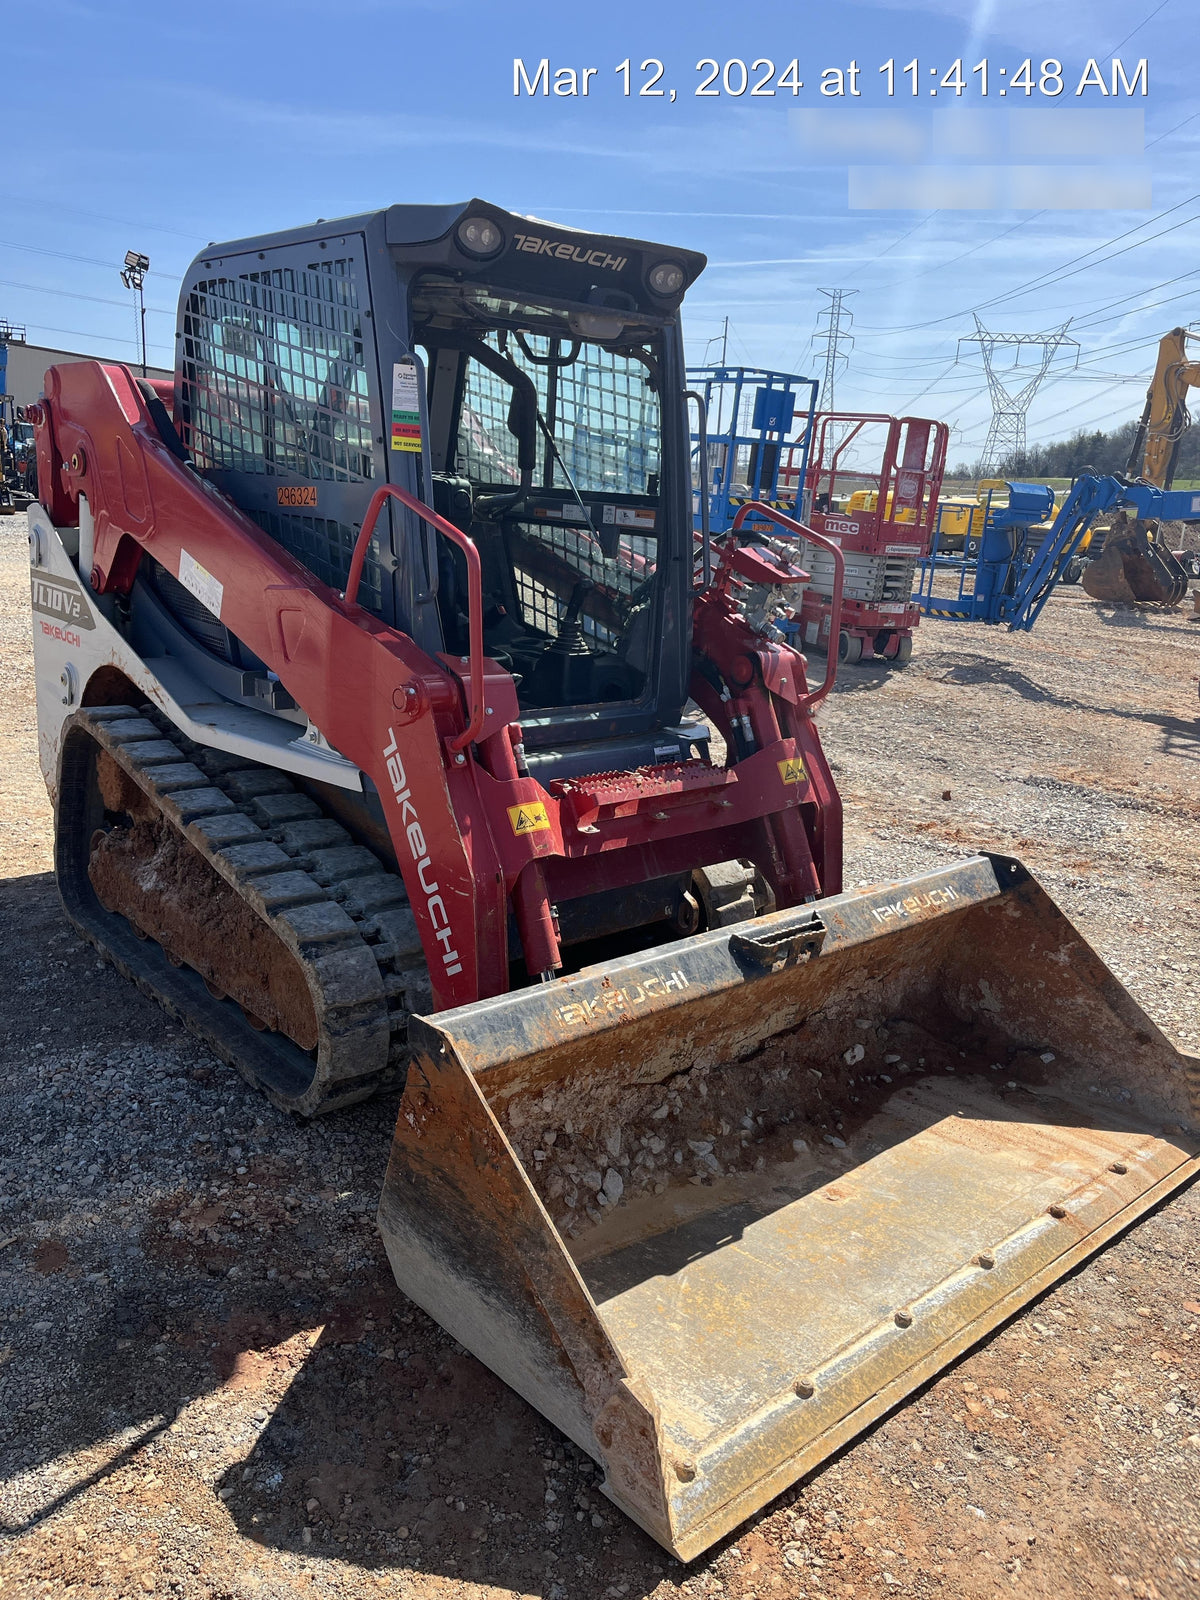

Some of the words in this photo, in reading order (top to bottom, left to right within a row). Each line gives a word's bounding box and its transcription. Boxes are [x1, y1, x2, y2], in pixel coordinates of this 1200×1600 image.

[513, 234, 628, 272] TAKEUCHI
[277, 486, 317, 505] 296324
[825, 520, 859, 534] mec
[39, 621, 81, 648] TAKEUCHI
[382, 727, 463, 978] TAKEUCHI
